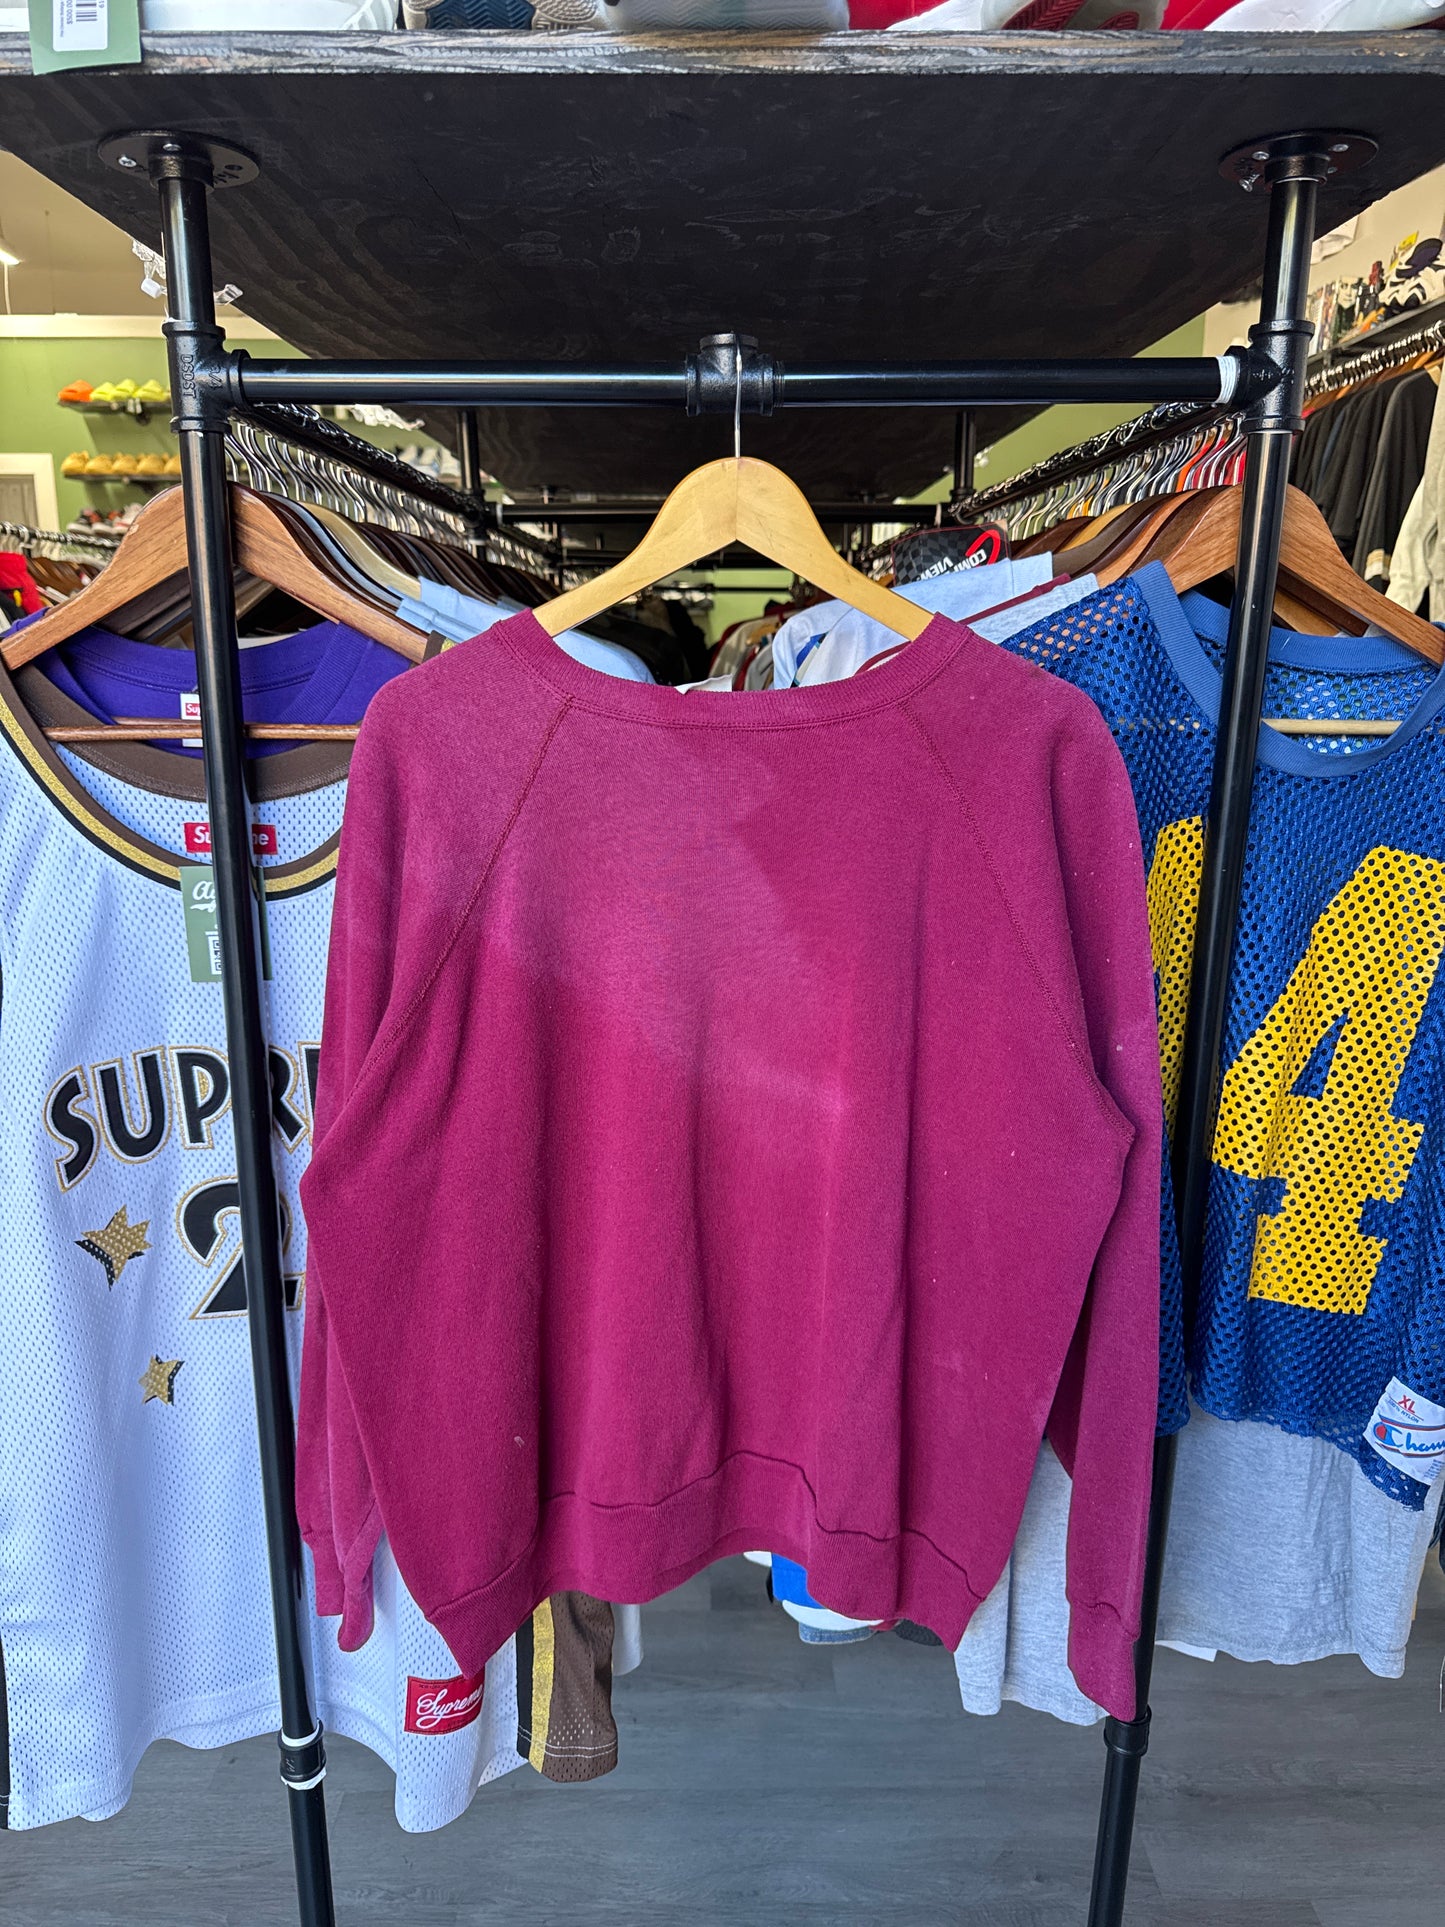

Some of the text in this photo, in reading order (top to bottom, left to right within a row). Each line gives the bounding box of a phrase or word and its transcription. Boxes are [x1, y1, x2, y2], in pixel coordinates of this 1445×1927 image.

[42, 1040, 322, 1194] SUPR
[1397, 1394, 1416, 1415] XL
[1401, 1410, 1420, 1424] NYLON
[1373, 1421, 1445, 1453] Cham
